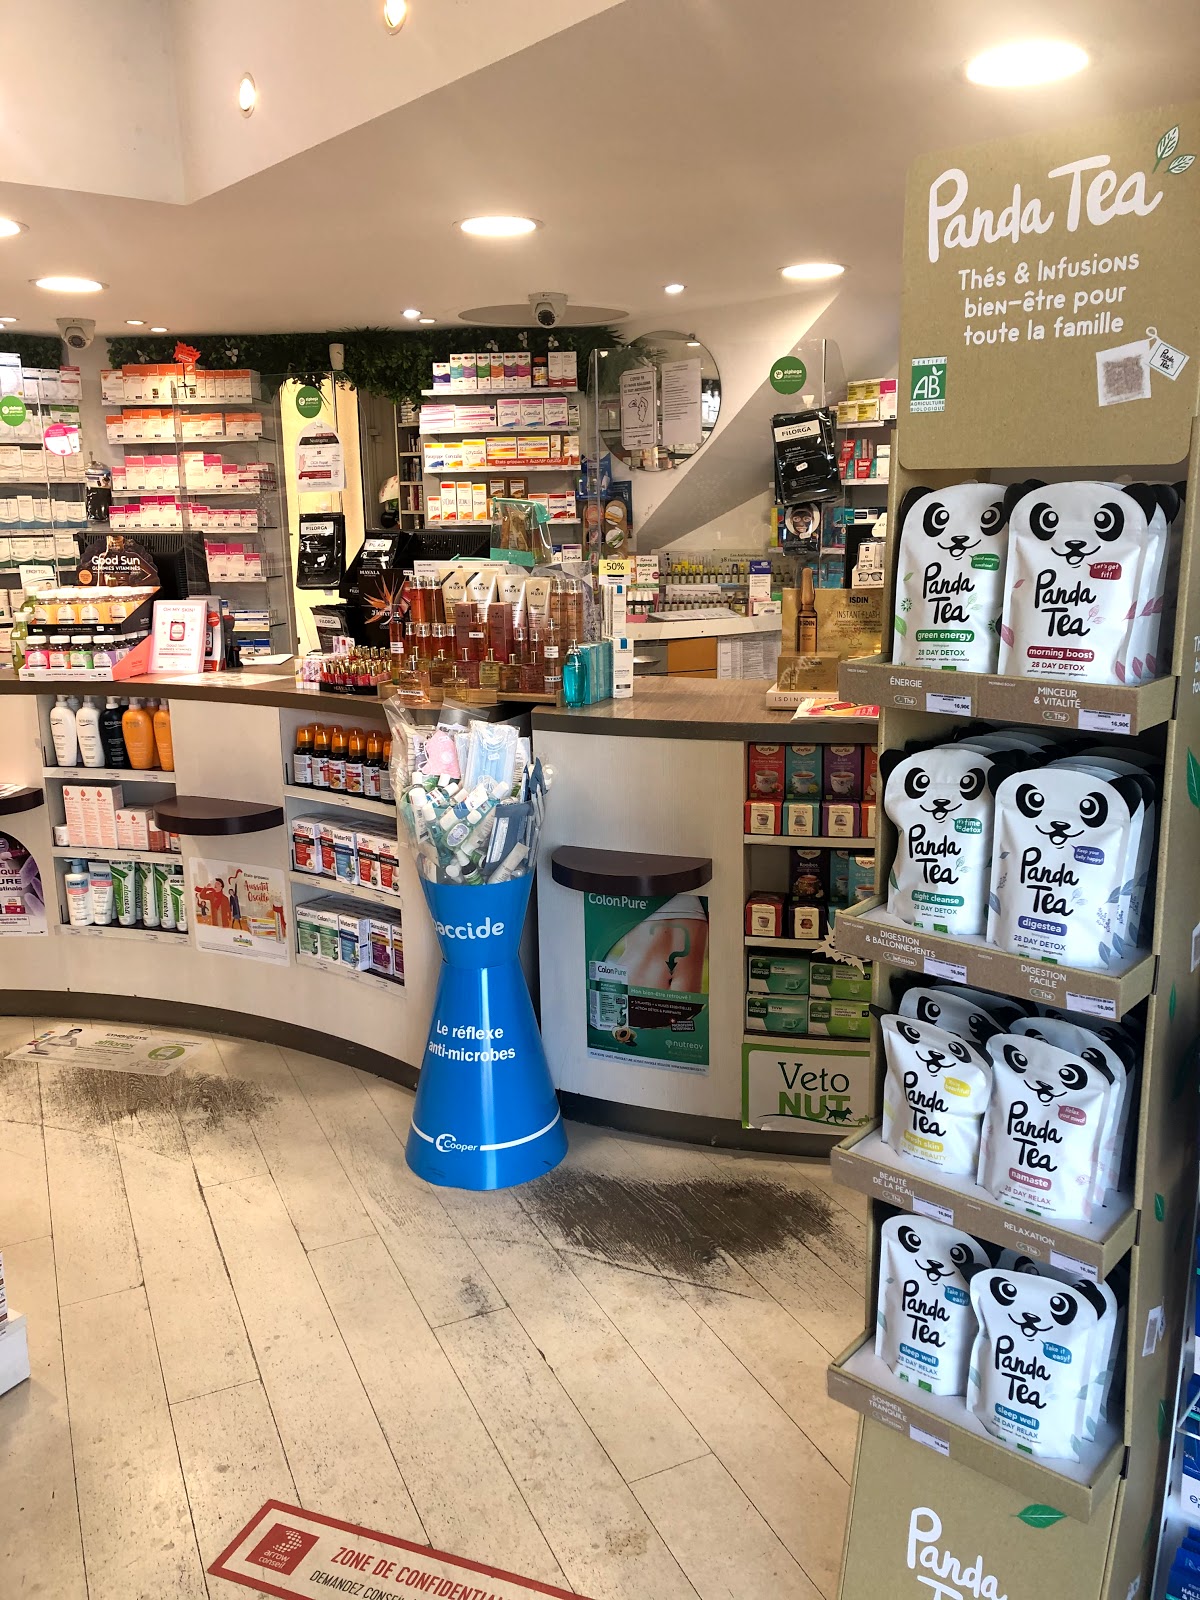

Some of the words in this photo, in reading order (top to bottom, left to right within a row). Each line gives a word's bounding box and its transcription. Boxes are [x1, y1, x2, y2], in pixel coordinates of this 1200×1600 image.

[929, 168, 1054, 263] Panda
[1048, 154, 1164, 232] Tea
[958, 266, 1006, 291] Thés
[1014, 262, 1030, 284] &
[1037, 253, 1140, 282] Infusions
[964, 289, 1066, 319] bien-être
[1073, 286, 1127, 314] pour
[963, 323, 1020, 346] toute
[1027, 320, 1045, 341] la
[1053, 312, 1124, 339] famille
[912, 375, 941, 400] AB
[781, 426, 812, 437] FILORGA
[92, 554, 119, 565] Good
[120, 555, 140, 565] Sun
[603, 562, 625, 571] -50%
[922, 562, 975, 599] Panda
[1034, 568, 1097, 609] Panda
[849, 596, 869, 604] ISDIN
[927, 596, 970, 625] Tea
[836, 611, 860, 619] INSTANT
[1041, 607, 1091, 637] Tea
[917, 632, 939, 642] green
[939, 631, 973, 642] energy
[1029, 648, 1064, 660] morning
[1066, 648, 1094, 659] boost
[1058, 663, 1085, 671] DETOX
[890, 676, 923, 688] ÉNERGIE
[1033, 697, 1041, 705] &
[1042, 696, 1082, 710] VITALITÉ
[1037, 687, 1078, 699] MINCEUR
[1054, 712, 1067, 721] Thé
[908, 823, 962, 859] Panda
[914, 858, 959, 885] Tea
[1020, 846, 1080, 887] Panda
[914, 892, 930, 902] night
[930, 894, 960, 905] cleanse
[1026, 885, 1074, 917] Tea
[920, 904, 934, 912] DAY
[934, 906, 958, 915] DETOX
[1022, 918, 1062, 933] digestea
[865, 934, 872, 943] &
[872, 936, 936, 959] BALLONNEMENTS
[880, 930, 920, 946] DIGESTION
[1013, 934, 1023, 942] 28
[1023, 936, 1038, 946] DAY
[1039, 939, 1067, 951] DETOX
[1020, 964, 1067, 982] DIGESTION
[1029, 976, 1057, 989] FACILE
[436, 1019, 449, 1035] Le
[452, 1024, 504, 1040] réflexe
[428, 1040, 516, 1062] anti-microbes
[777, 1061, 850, 1093] Veto
[904, 1070, 949, 1113] Panda
[778, 1091, 851, 1119] NUT
[909, 1104, 947, 1137] Tea
[1006, 1100, 1063, 1144] Panda
[443, 1138, 478, 1152] Cooper
[923, 1140, 940, 1151] skin
[1012, 1137, 1058, 1173] Tea
[872, 1176, 883, 1185] DE
[883, 1179, 894, 1189] LA
[895, 1183, 915, 1197] PEAU
[879, 1170, 907, 1187] BEAUTÉ
[1011, 1170, 1050, 1188] namaste
[1004, 1184, 1012, 1193] 28
[1012, 1187, 1027, 1199] DAY
[1027, 1193, 1051, 1206] RELAX
[1004, 1221, 1056, 1247] RELAXATION
[902, 1279, 950, 1322] Panda
[946, 1287, 959, 1296] Take
[906, 1313, 946, 1348] Tea
[901, 1345, 920, 1359] sleep
[920, 1353, 937, 1366] well
[994, 1335, 1051, 1381] Panda
[1045, 1343, 1059, 1353] Take
[1052, 1353, 1072, 1364] easy!
[904, 1358, 917, 1369] DAY
[918, 1363, 938, 1376] RELAX
[1001, 1372, 1047, 1410] Tea
[871, 1394, 904, 1414] SOMMEIL
[997, 1405, 1018, 1420] sleep
[1018, 1414, 1037, 1428] well
[1001, 1419, 1016, 1430] DAY
[1016, 1426, 1038, 1439] RELAX
[258, 1555, 287, 1570] conseil
[263, 1549, 291, 1563] arrow
[330, 1546, 375, 1573] ZONE
[372, 1558, 397, 1579] DE
[906, 1506, 1009, 1600] Panda
[309, 1569, 365, 1596] DEMANDEZ
